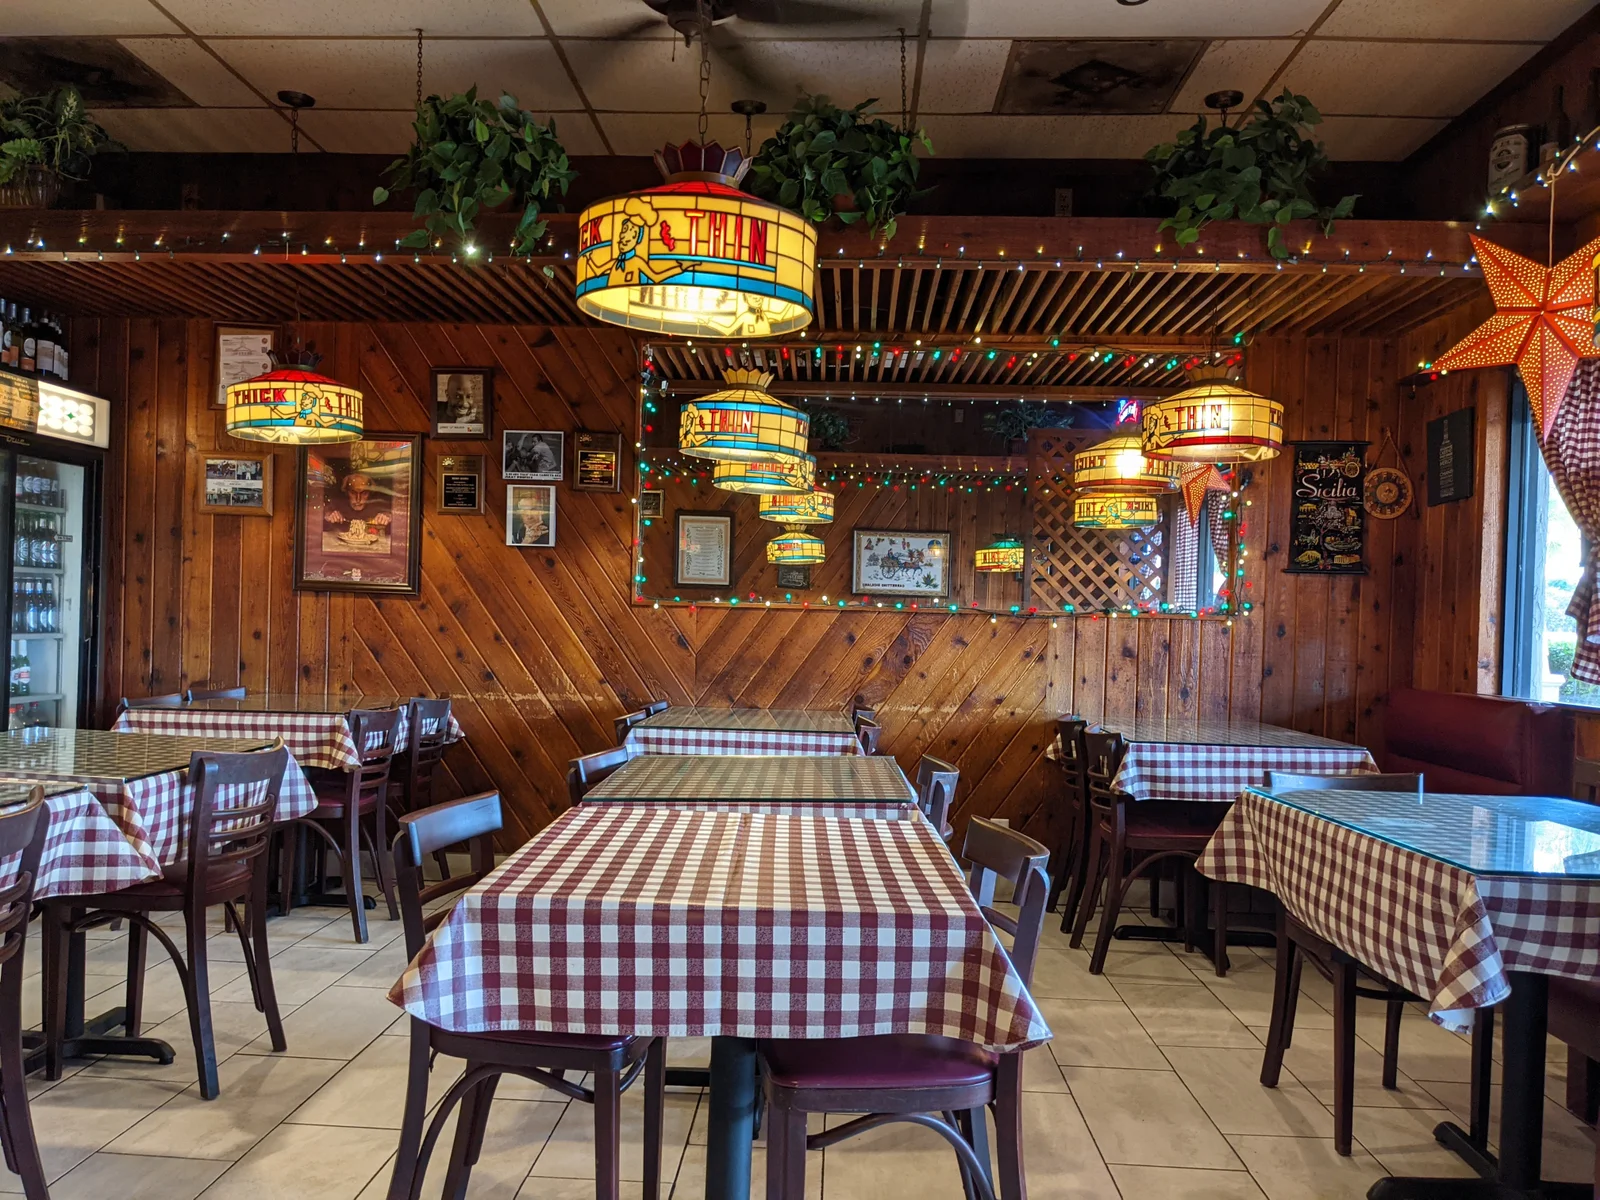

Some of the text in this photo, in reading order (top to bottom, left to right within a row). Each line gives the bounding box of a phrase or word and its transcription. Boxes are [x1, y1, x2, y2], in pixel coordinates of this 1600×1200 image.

[684, 210, 768, 265] THIN
[233, 387, 287, 406] THICK
[709, 409, 754, 434] THIN
[1174, 404, 1222, 431] THIN
[1295, 473, 1358, 498] Sicilia
